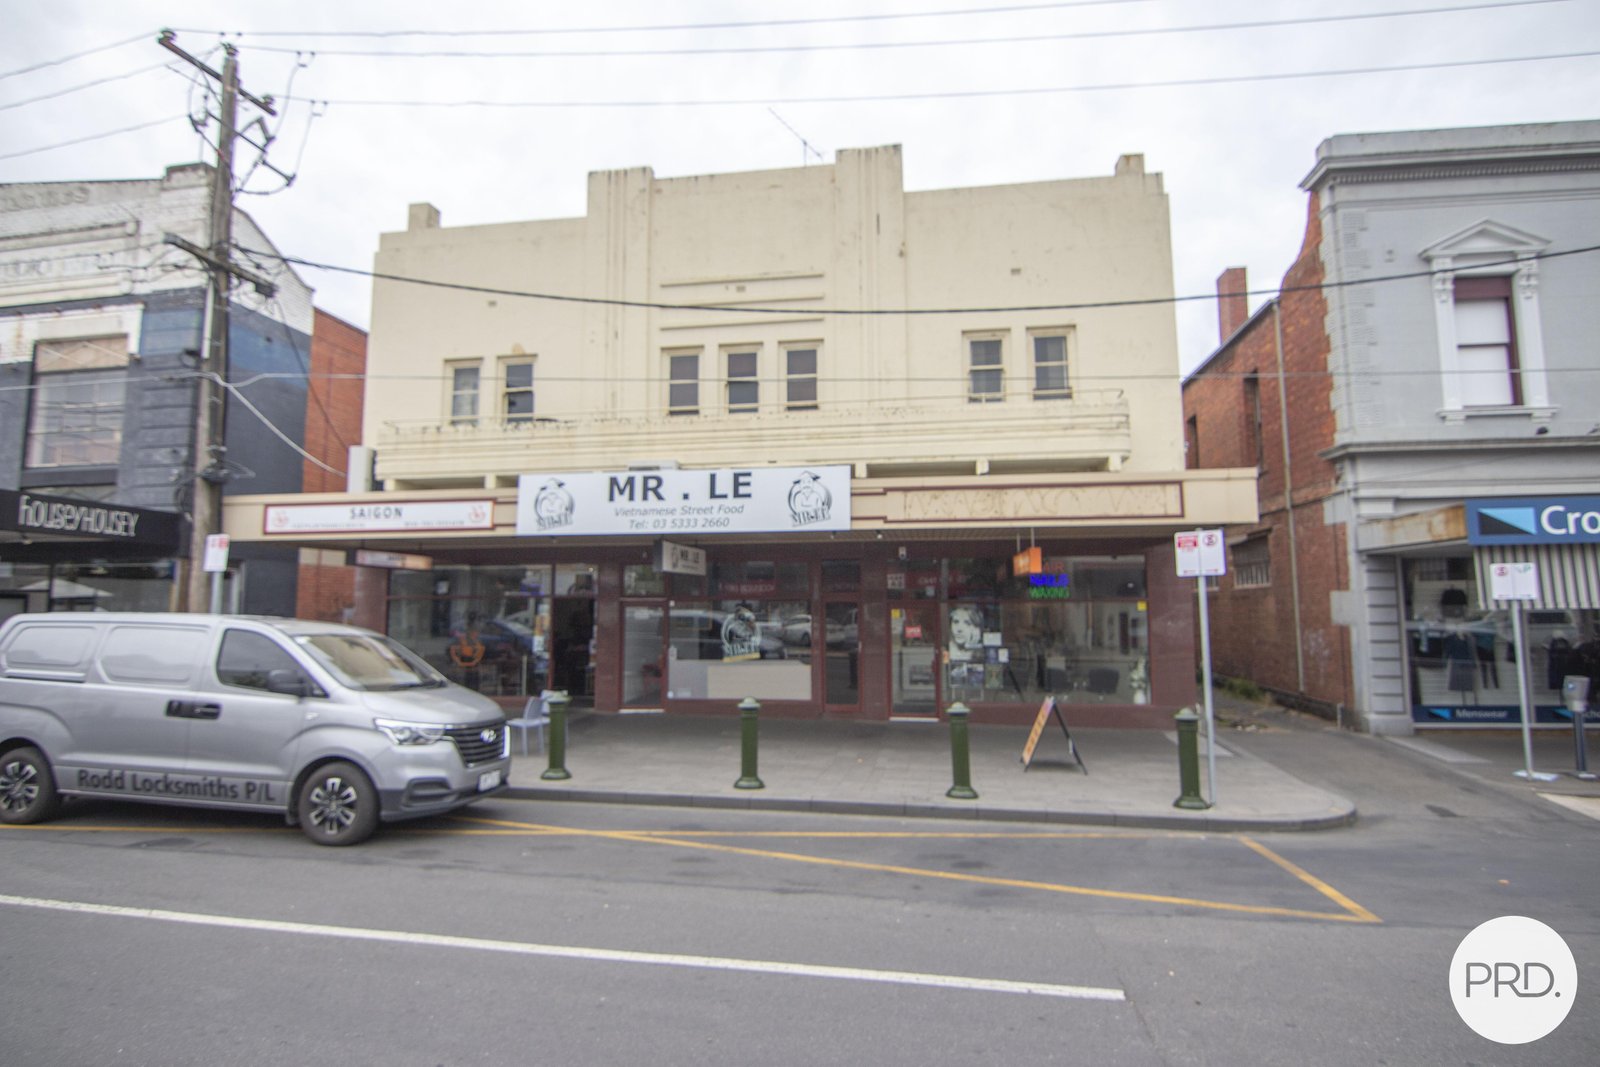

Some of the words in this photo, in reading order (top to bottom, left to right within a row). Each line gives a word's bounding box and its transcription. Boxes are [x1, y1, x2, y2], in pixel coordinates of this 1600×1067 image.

[608, 475, 665, 502] MR
[709, 472, 752, 499] LE
[350, 506, 403, 520] SAIGON
[614, 505, 677, 517] Vietnamese
[681, 504, 714, 516] Street
[718, 503, 745, 514] Food
[629, 519, 648, 529] Tel:
[653, 518, 667, 528] 03
[671, 518, 698, 528] 5333
[701, 517, 730, 527] 2660
[1455, 708, 1508, 719] Menswear
[77, 769, 126, 790] Rodd
[131, 773, 239, 799] Locksmiths
[245, 781, 276, 801] P/L
